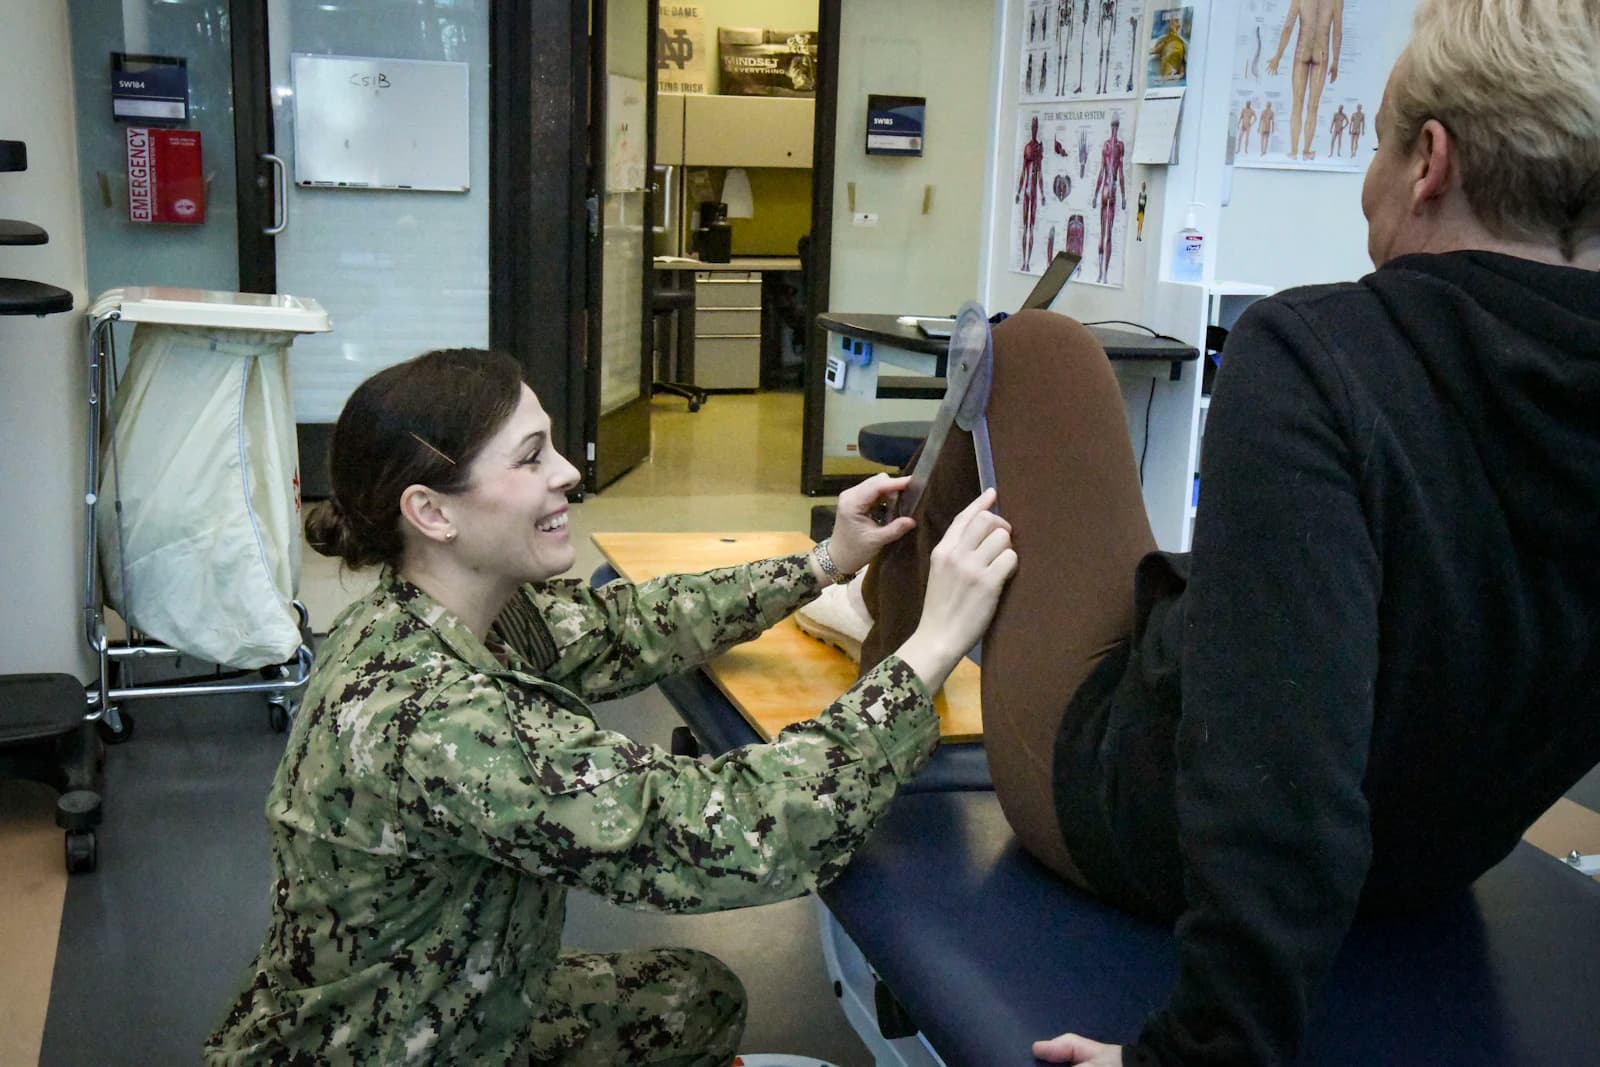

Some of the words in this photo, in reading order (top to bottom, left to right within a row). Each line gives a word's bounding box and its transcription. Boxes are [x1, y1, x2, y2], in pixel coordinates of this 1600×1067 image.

[724, 56, 779, 68] MINDSET
[734, 66, 785, 74] EVERYTHING
[680, 82, 704, 93] IRISH
[1044, 111, 1054, 121] THE
[1055, 111, 1083, 121] MUSCULAR
[1084, 110, 1106, 121] SYSTEM
[129, 129, 149, 220] EMERGENCY
